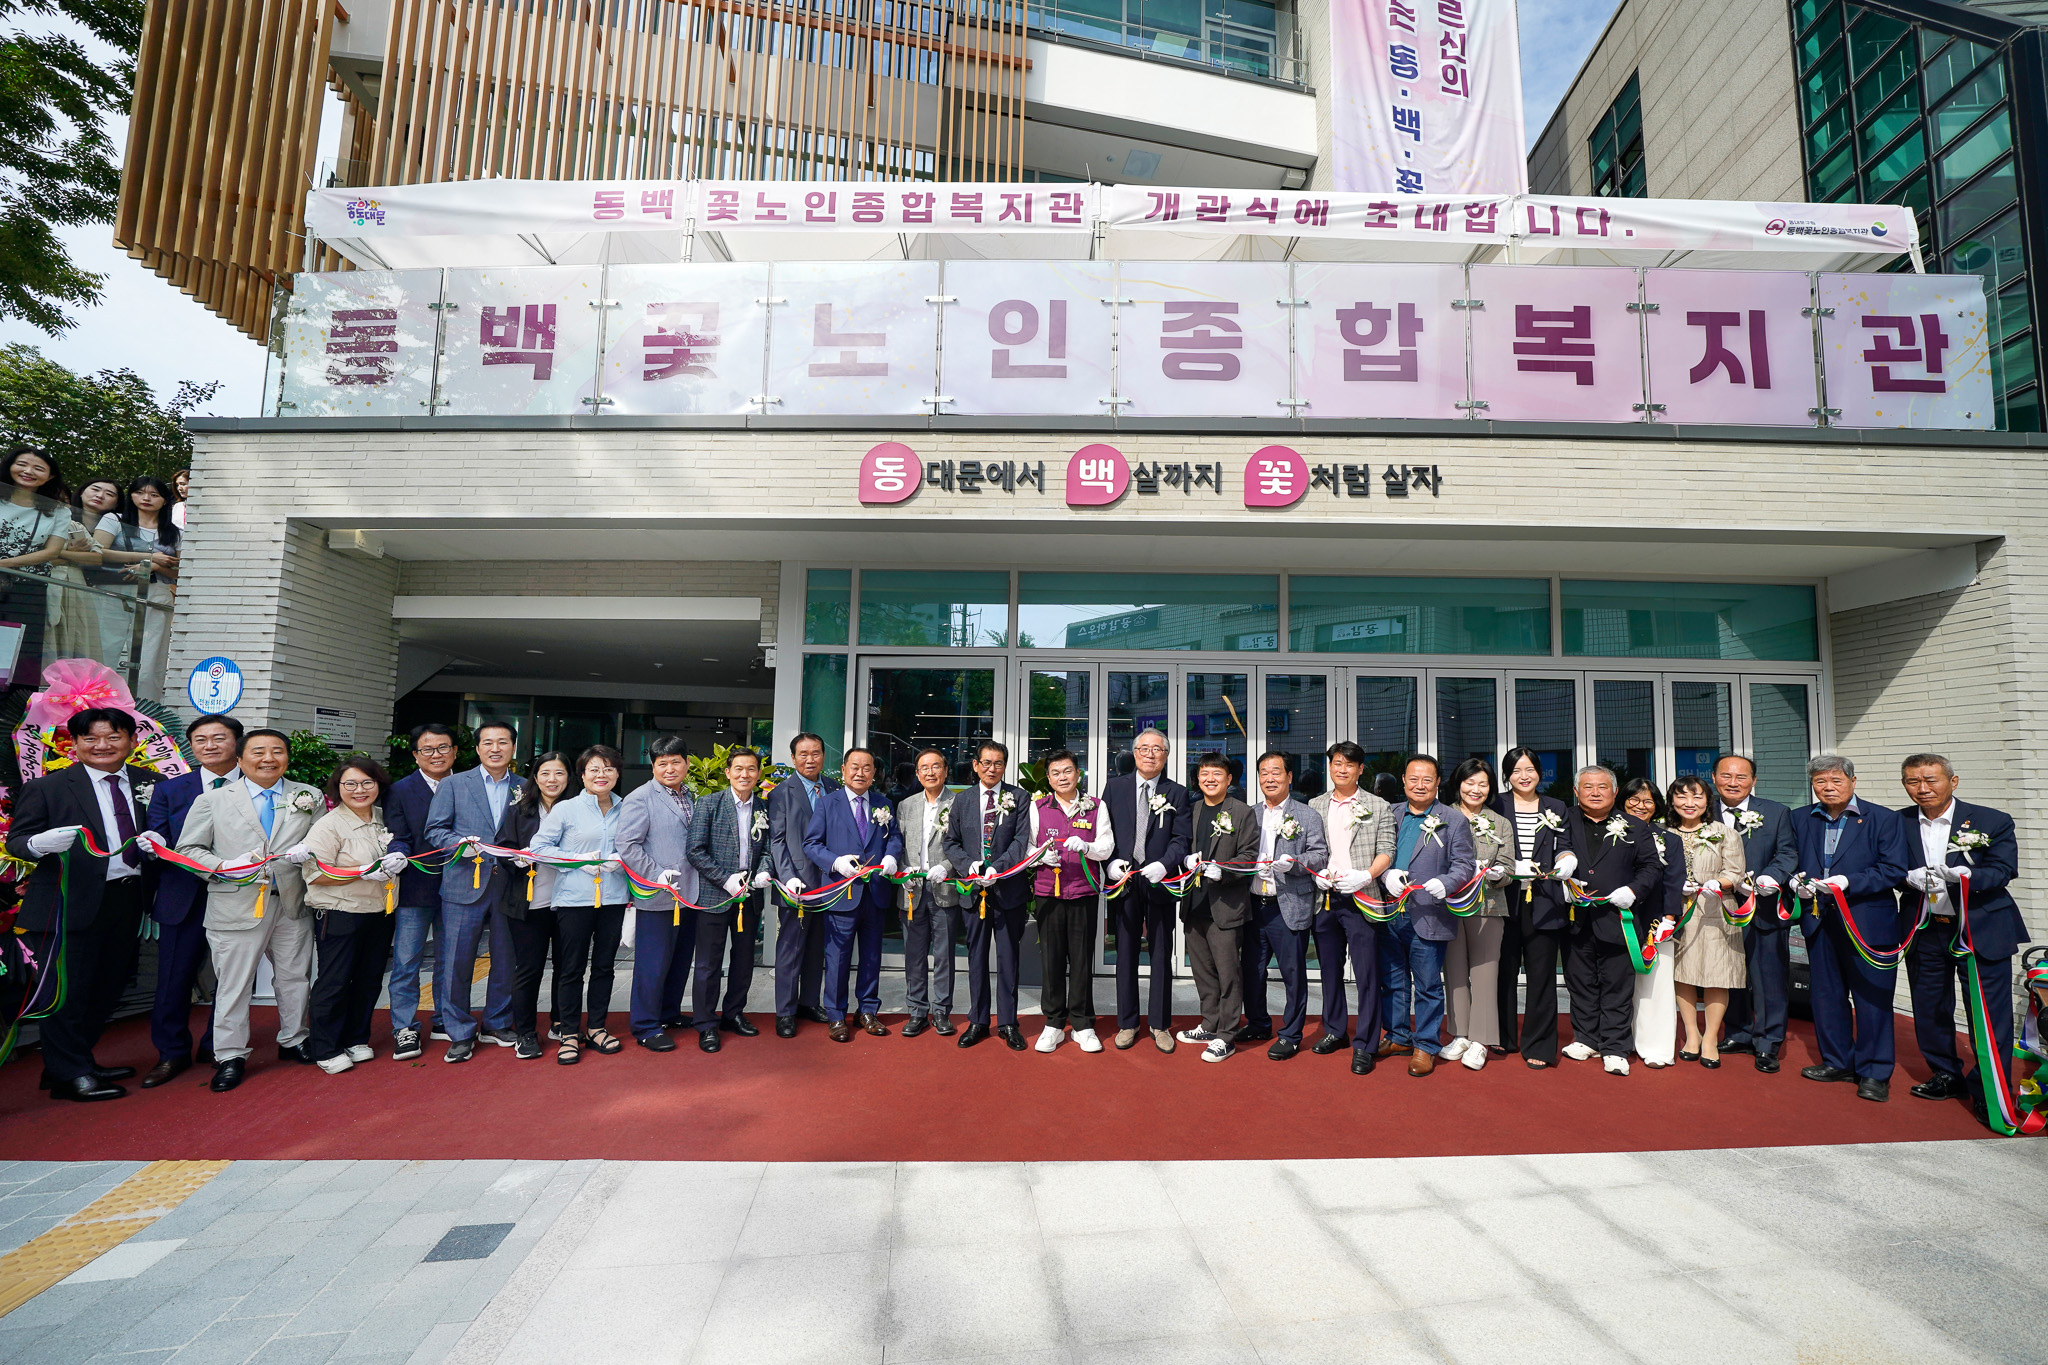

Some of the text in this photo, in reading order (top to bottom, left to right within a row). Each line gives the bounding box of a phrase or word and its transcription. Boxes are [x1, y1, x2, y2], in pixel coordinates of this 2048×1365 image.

[354, 208, 386, 226] 동대문
[1145, 191, 1330, 228] 개관식에
[1381, 464, 1442, 497] 살자
[210, 680, 220, 697] 3
